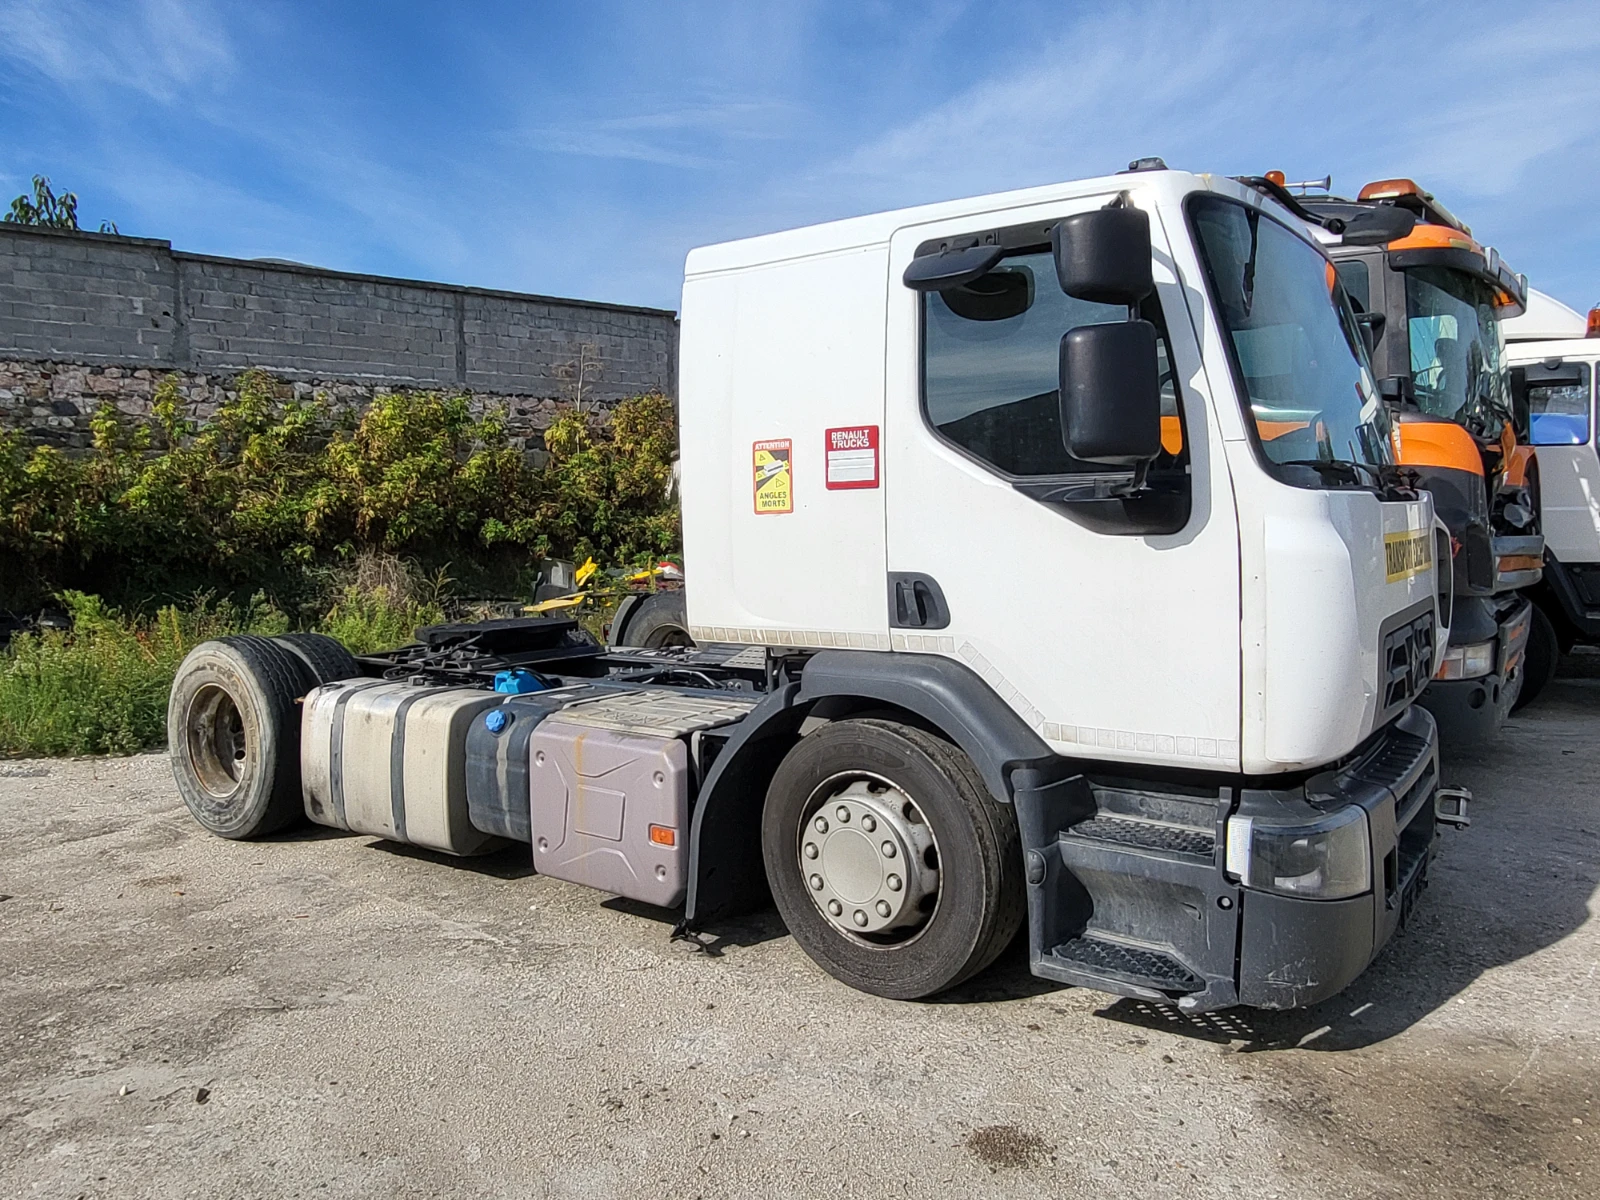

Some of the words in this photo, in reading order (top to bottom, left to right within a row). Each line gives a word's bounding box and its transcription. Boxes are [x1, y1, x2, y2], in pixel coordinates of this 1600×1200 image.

[831, 429, 869, 441] RENAULT
[755, 440, 790, 451] ATTENTION
[831, 438, 870, 449] TRUCKS
[759, 491, 787, 500] ANGLES
[761, 499, 786, 508] MORTS
